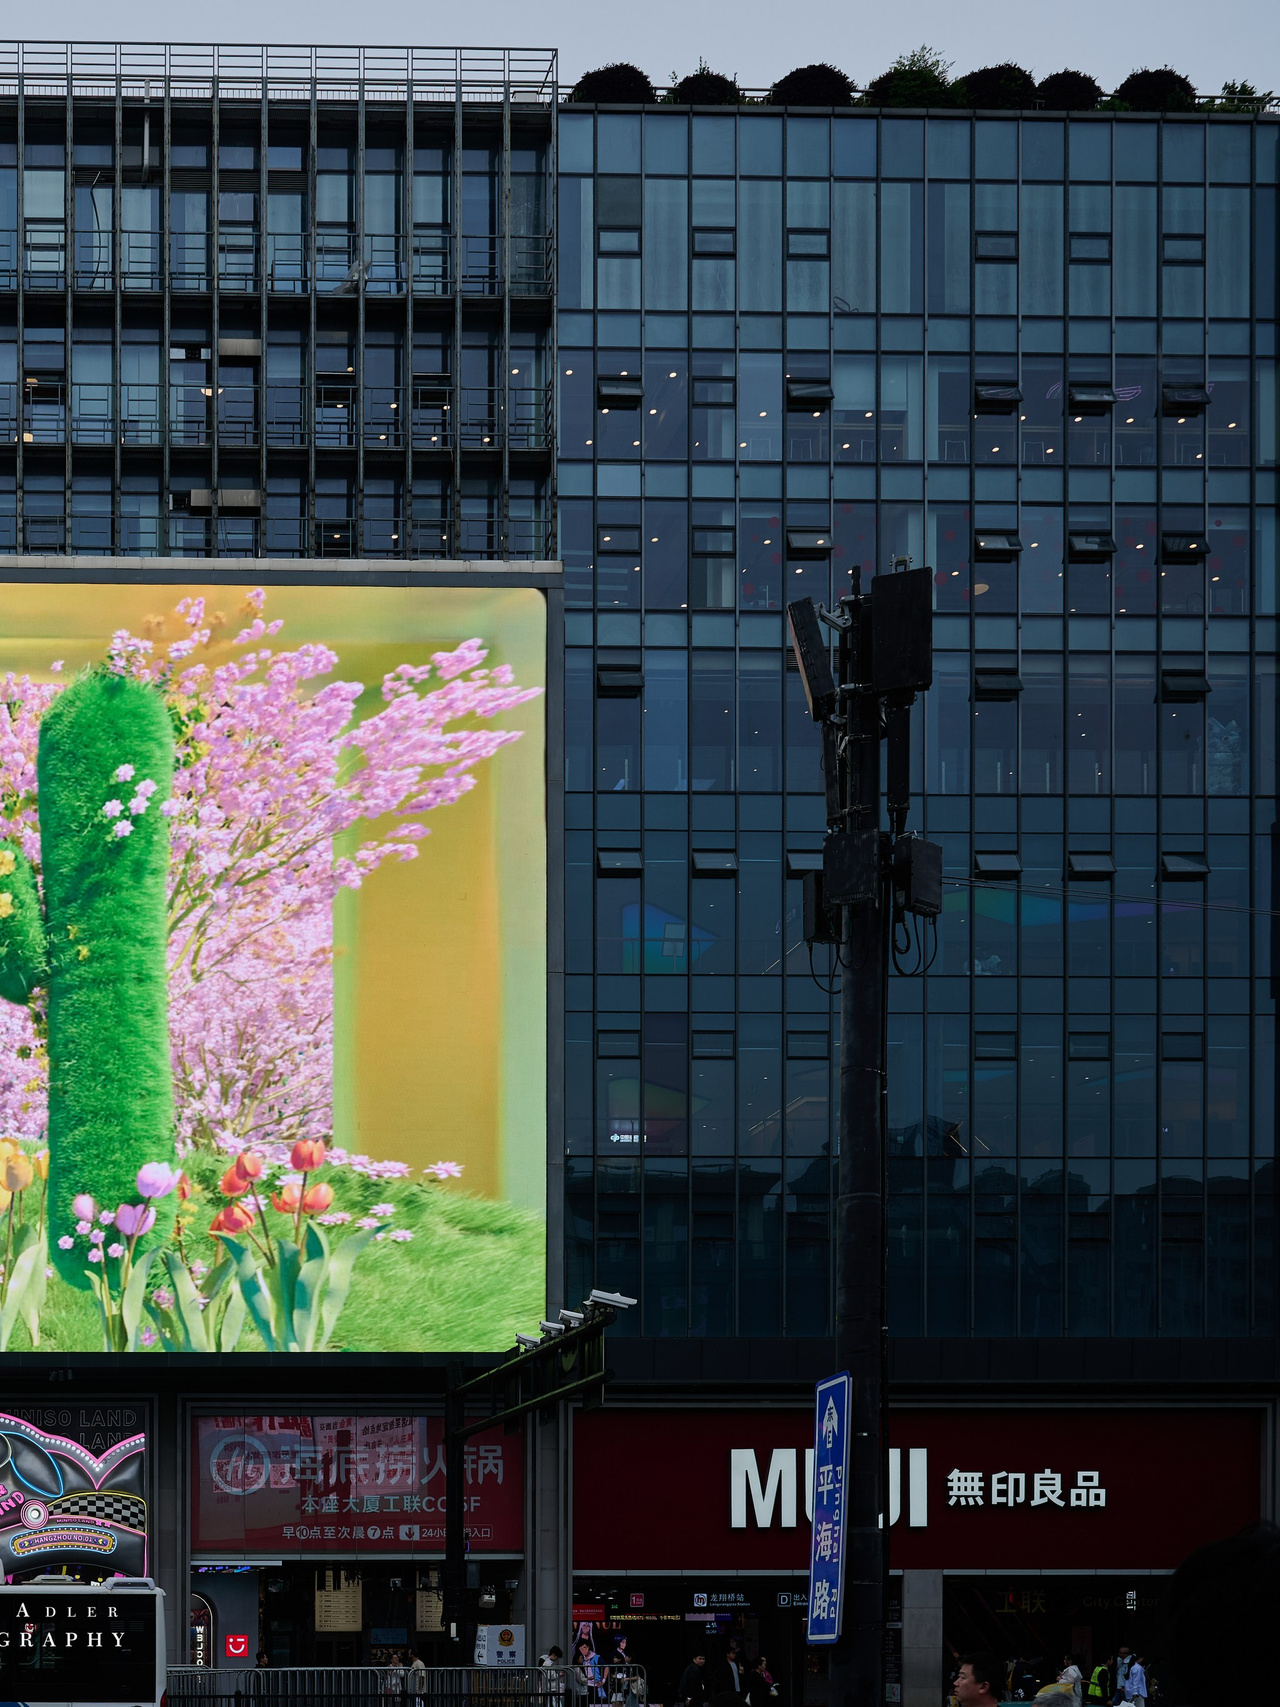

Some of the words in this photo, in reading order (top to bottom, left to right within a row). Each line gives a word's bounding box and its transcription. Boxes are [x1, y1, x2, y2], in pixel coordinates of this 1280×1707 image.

[79, 1409, 137, 1427] LAND
[730, 1447, 928, 1528] MJI
[946, 1468, 1106, 1508] 無印良品
[832, 1466, 842, 1563] Pinghai
[34, 1534, 72, 1543] HANGZHOU
[812, 1464, 835, 1621] 平海路
[710, 1592, 745, 1602] 龙翔桥站
[780, 1595, 789, 1605] D
[793, 1593, 808, 1601] 出入
[830, 1588, 838, 1618] Rd
